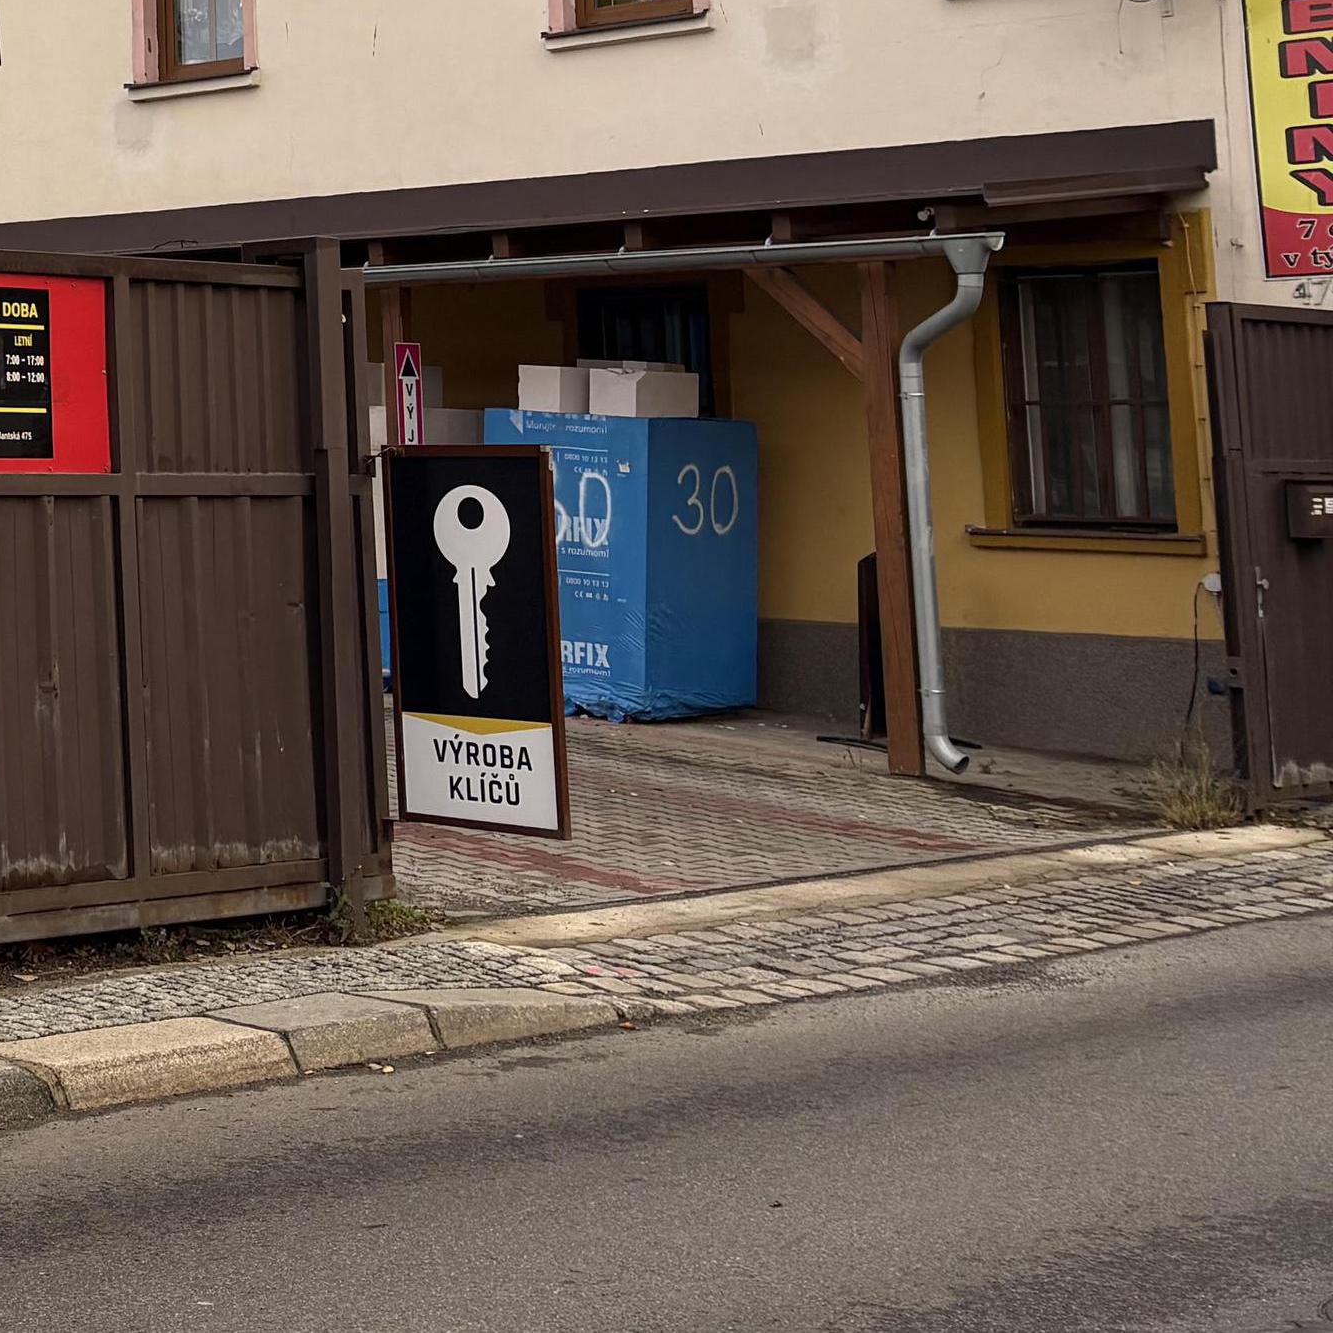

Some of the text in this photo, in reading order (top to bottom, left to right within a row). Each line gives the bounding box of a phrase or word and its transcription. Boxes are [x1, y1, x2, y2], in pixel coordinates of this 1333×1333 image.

[2, 301, 39, 319] DOBA
[14, 333, 33, 347] LETNÍ
[672, 463, 739, 535] 30
[433, 733, 533, 772] VÝROBA
[448, 772, 521, 807] KLÍČŮ
